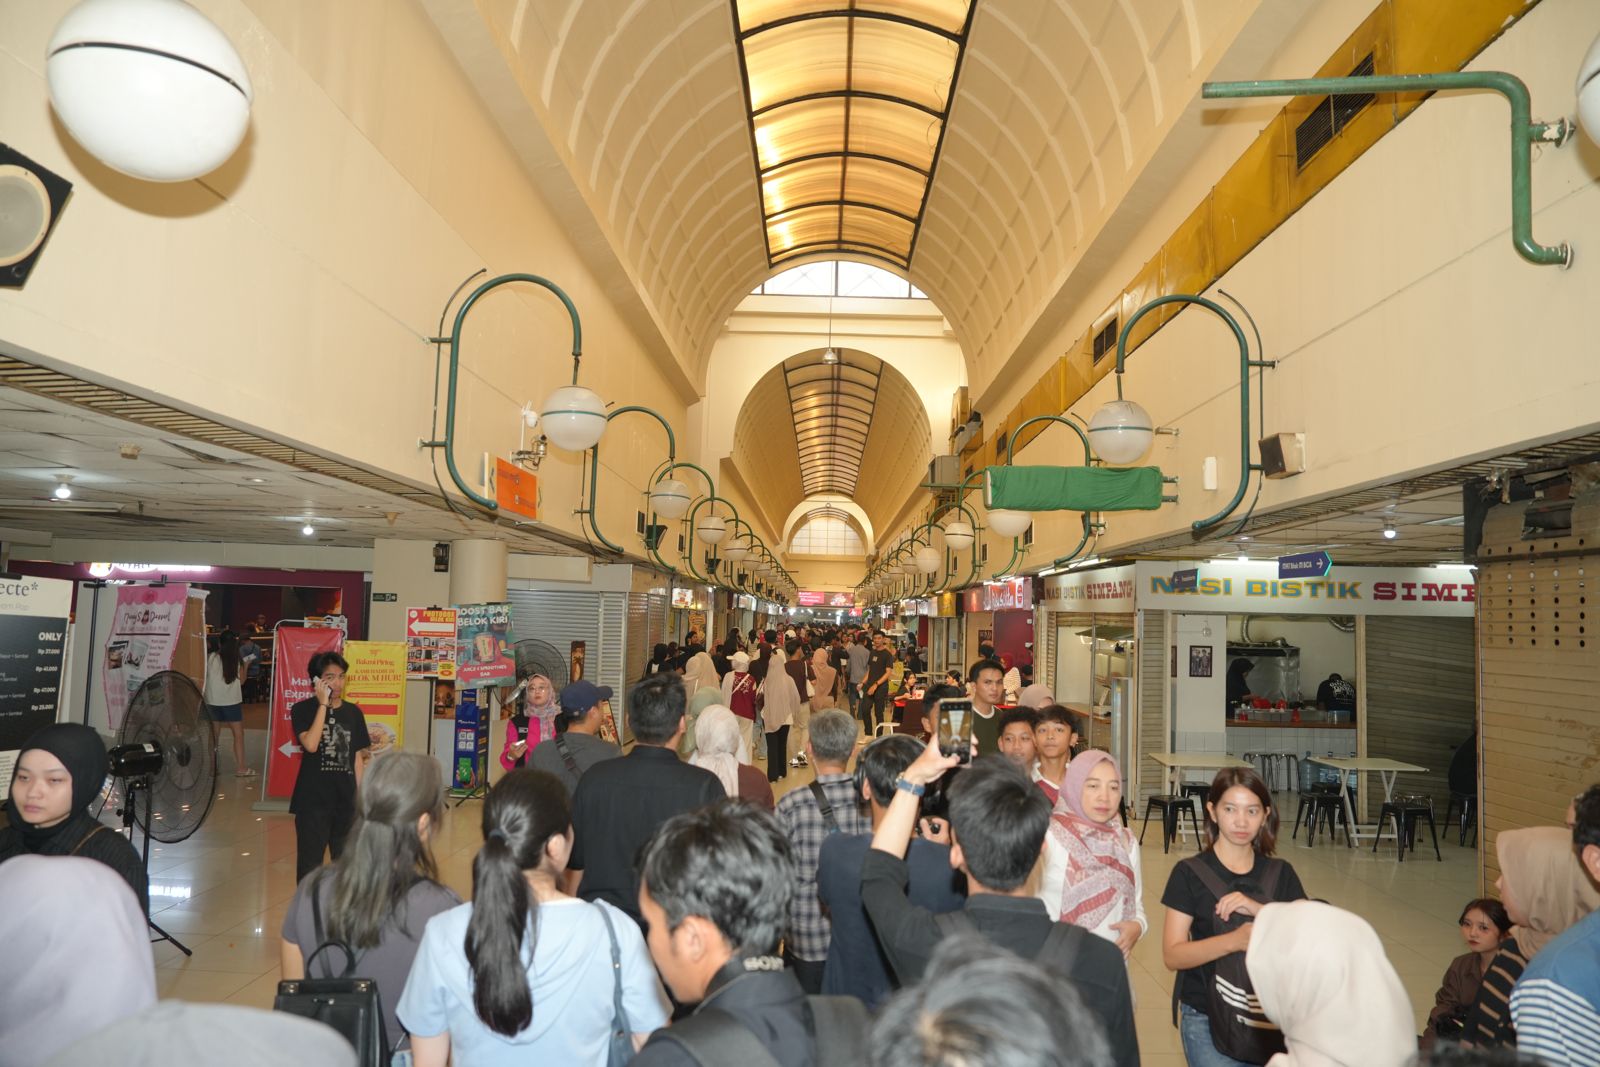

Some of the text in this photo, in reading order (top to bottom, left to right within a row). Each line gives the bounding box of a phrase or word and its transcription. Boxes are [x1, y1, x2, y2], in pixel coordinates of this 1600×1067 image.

[1086, 580, 1133, 600] SIMPANG
[1245, 579, 1362, 599] BISTIK
[488, 604, 509, 615] BAR
[457, 615, 508, 627] BELOK KIRI
[38, 631, 63, 641] ONLY
[347, 674, 370, 682] BLOK
